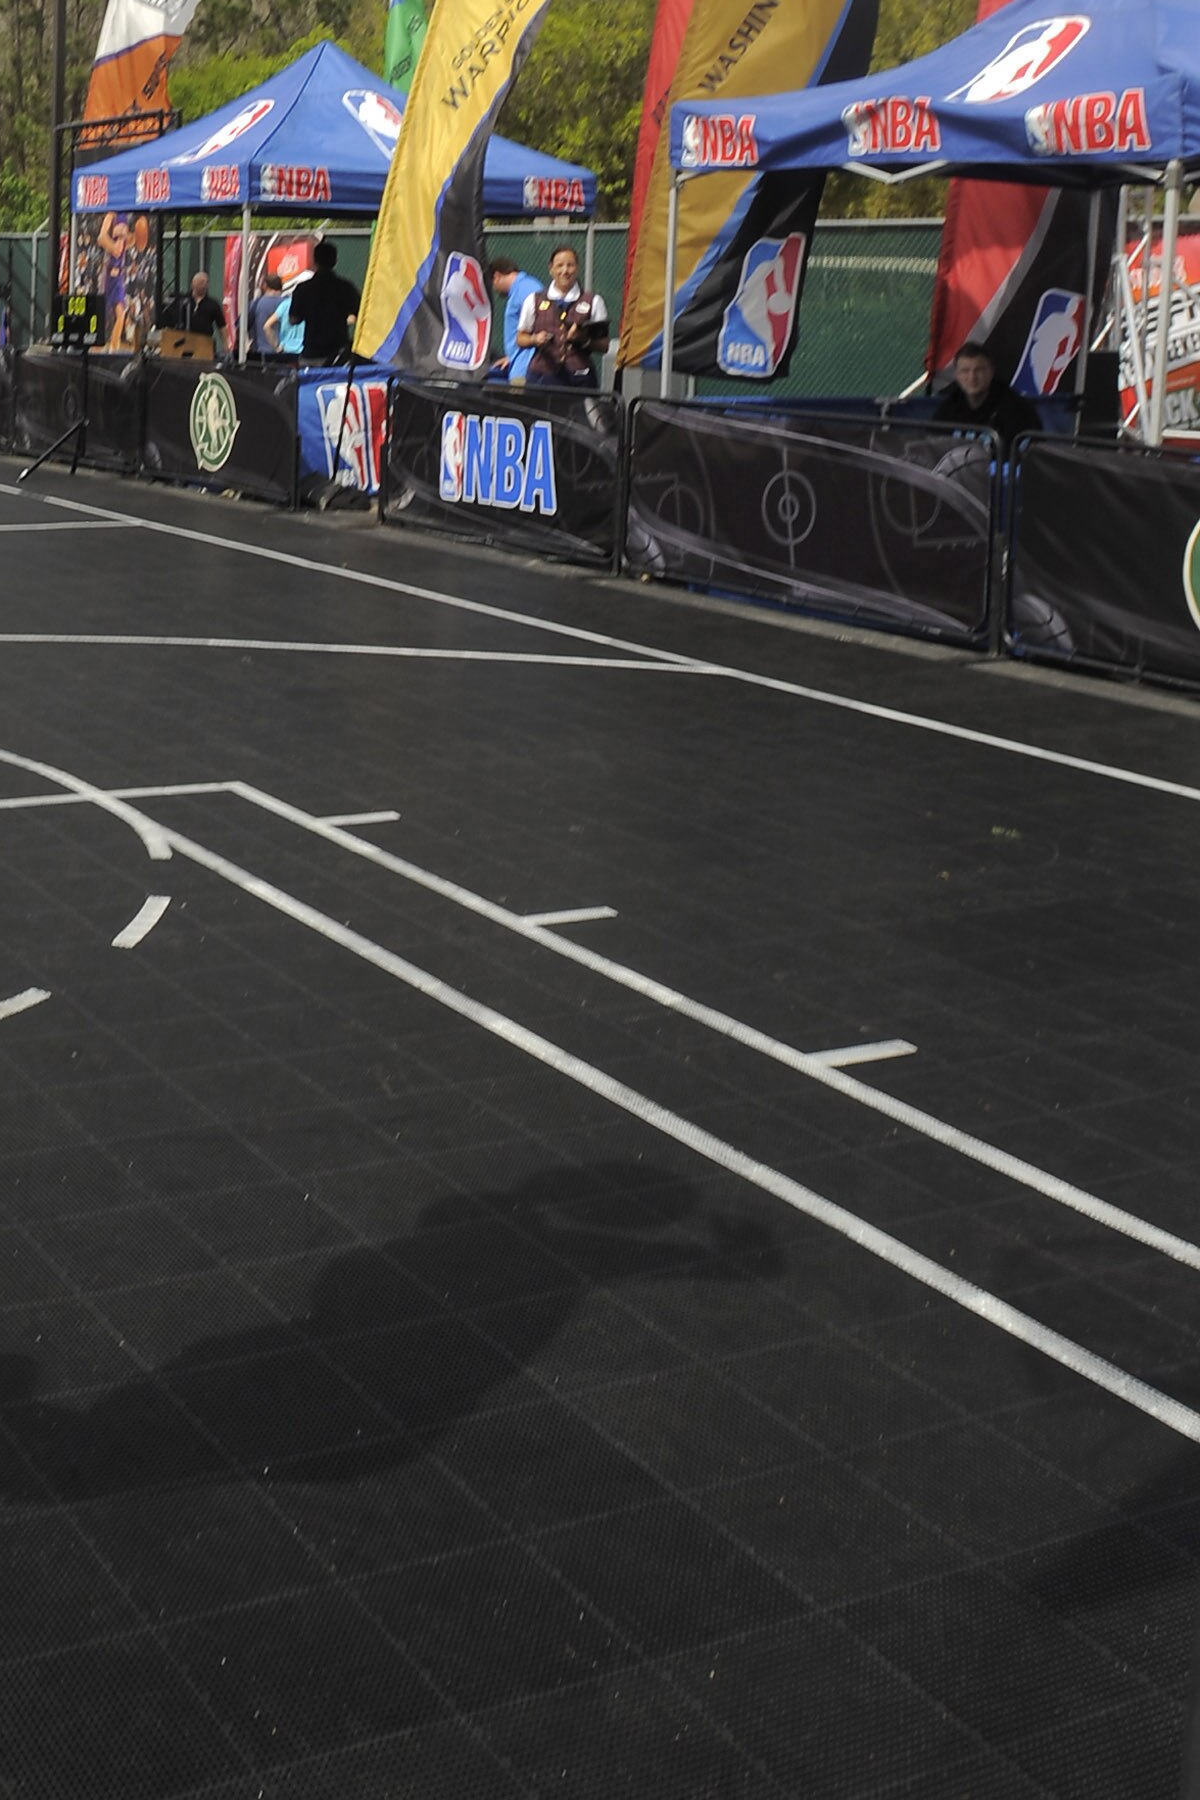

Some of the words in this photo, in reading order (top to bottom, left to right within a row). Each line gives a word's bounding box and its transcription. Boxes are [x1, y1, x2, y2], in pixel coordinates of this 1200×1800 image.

[699, 114, 759, 166] NBA
[869, 96, 942, 153] NBA
[1050, 87, 1151, 155] NBA
[275, 167, 332, 201] NBA
[536, 177, 585, 212] NBA
[444, 340, 472, 362] NBA
[726, 342, 766, 367] NBA
[462, 414, 558, 516] NBA
